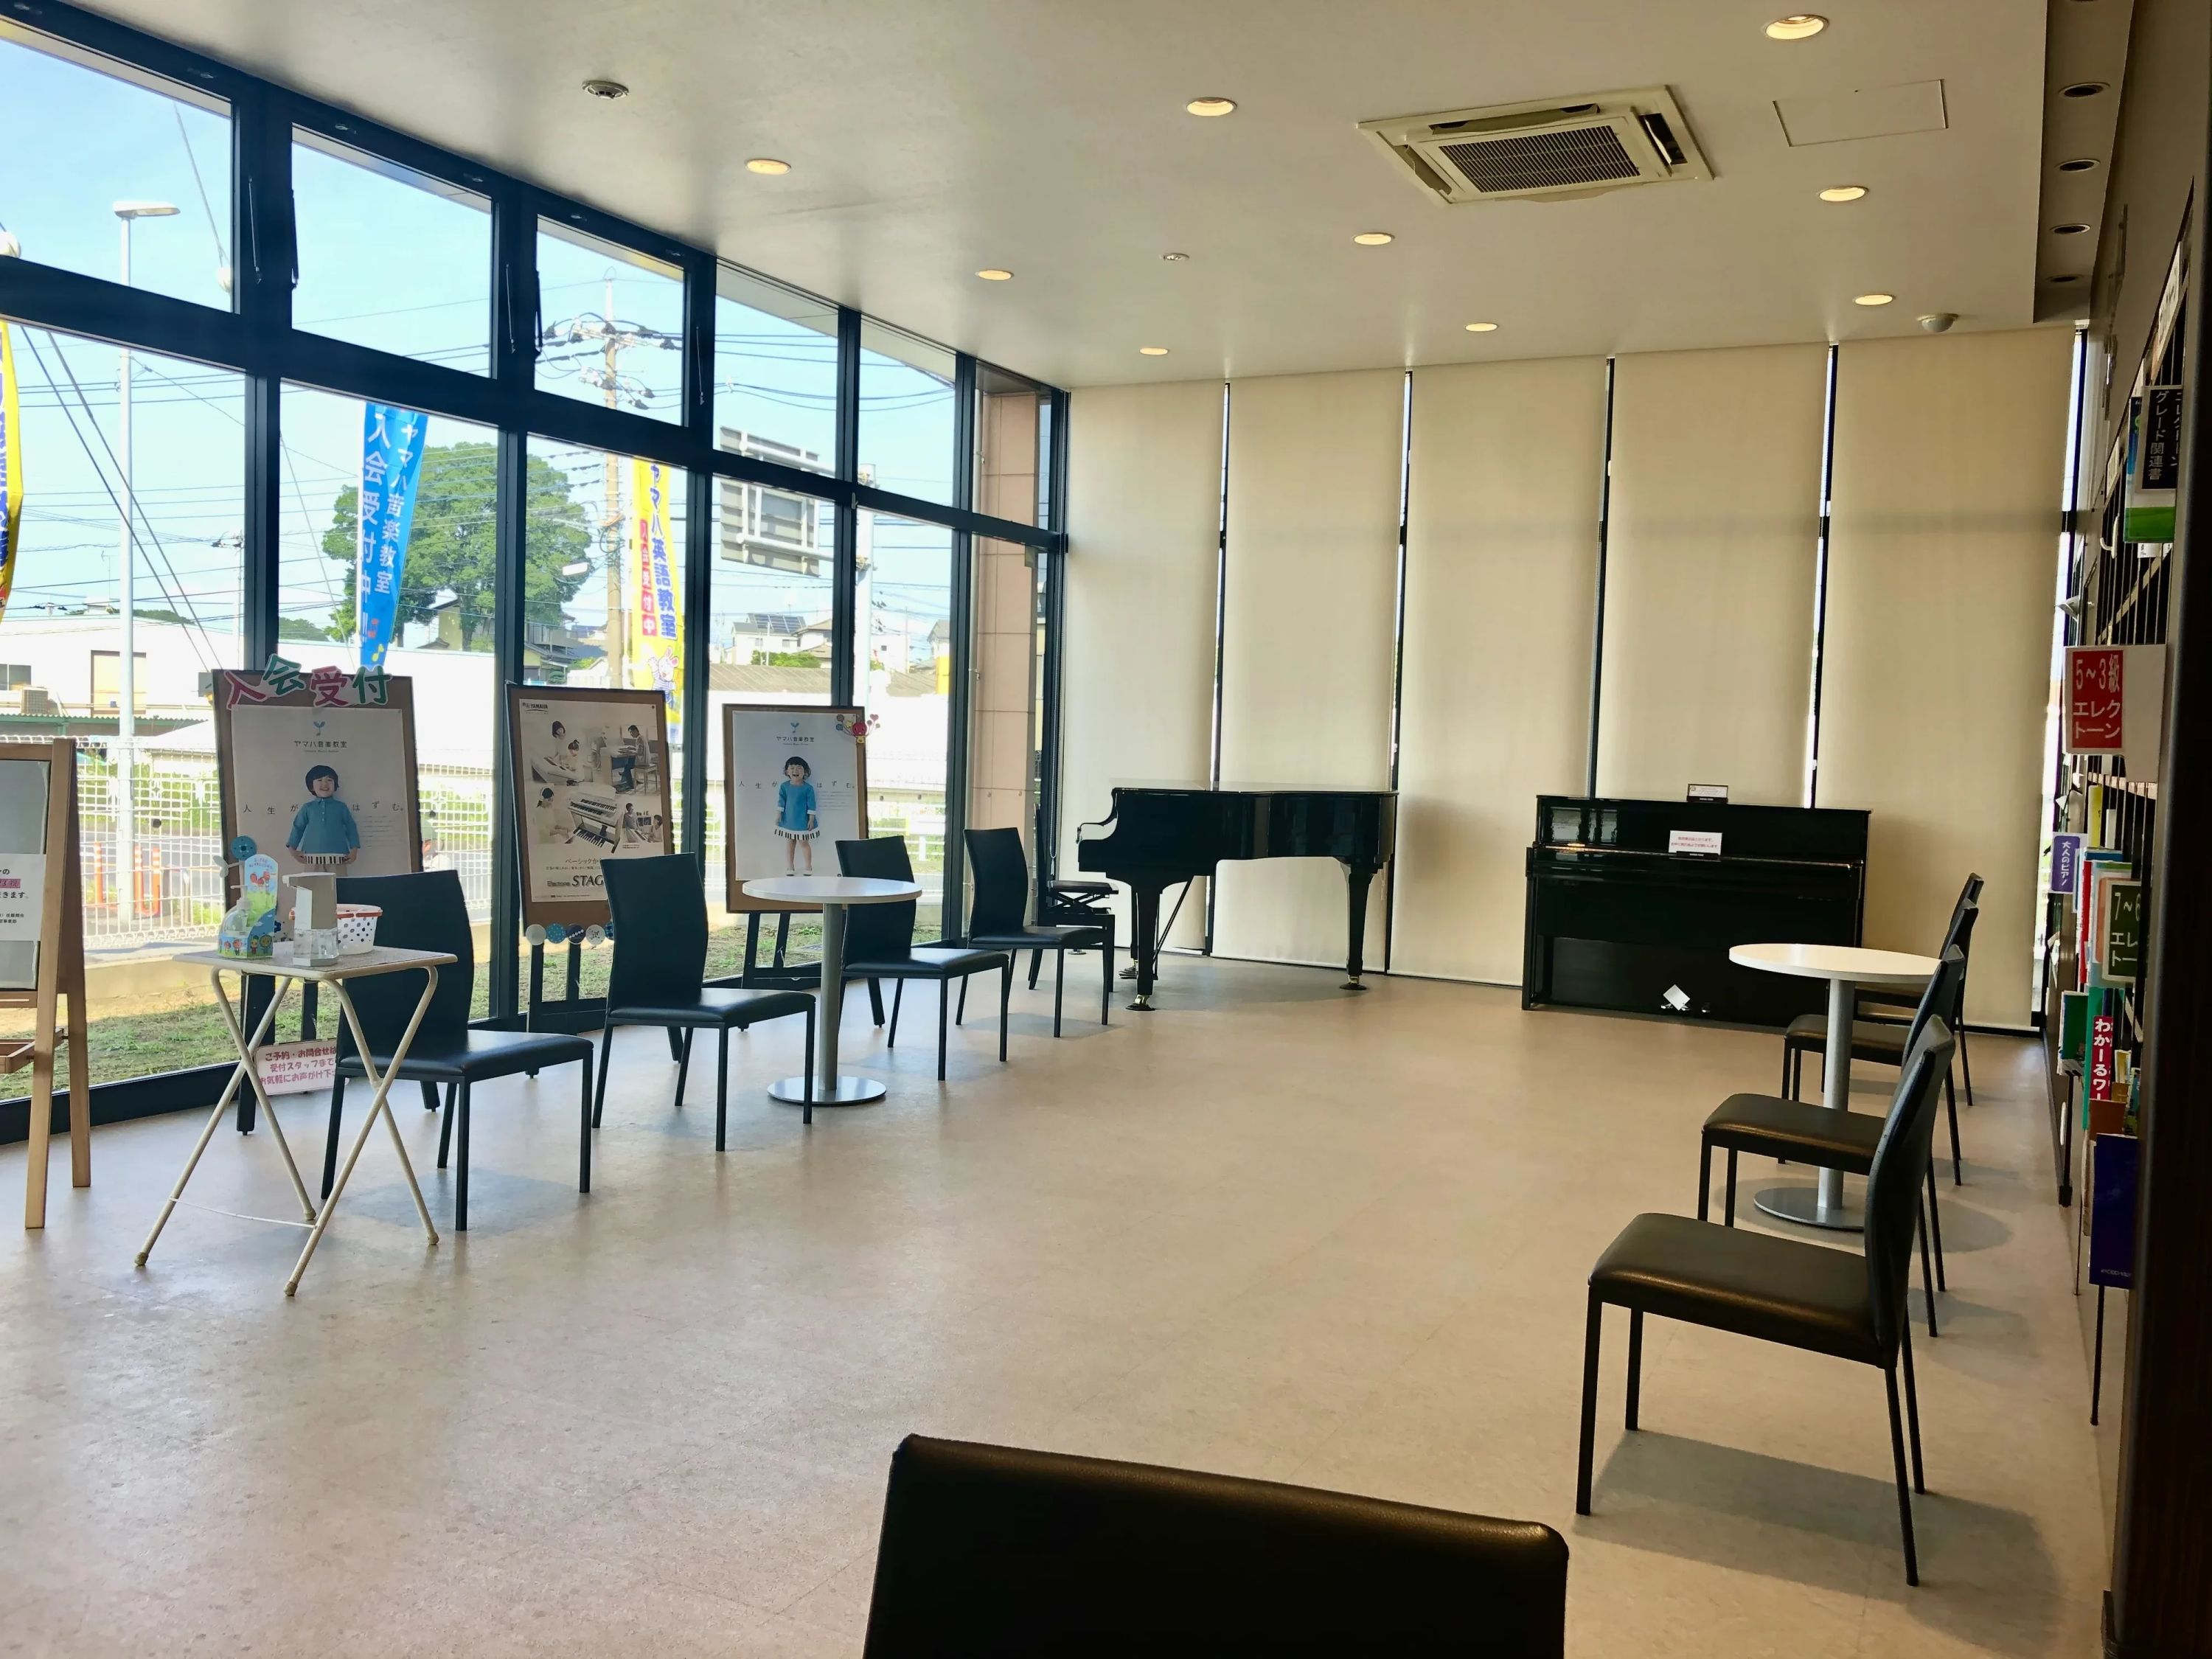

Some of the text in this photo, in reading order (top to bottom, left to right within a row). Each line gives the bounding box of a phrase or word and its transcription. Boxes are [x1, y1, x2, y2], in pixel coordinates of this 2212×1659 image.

[2149, 391, 2169, 480] グレード関連書
[375, 423, 419, 594] ヤマハ音楽教室
[640, 520, 657, 636] 入会受付中
[650, 464, 677, 639] ヤマハ英語教室
[224, 654, 392, 708] 入会受付
[2073, 700, 2121, 718] エレク
[2075, 722, 2121, 739] トーン
[2061, 841, 2071, 886] 大人のピアノ
